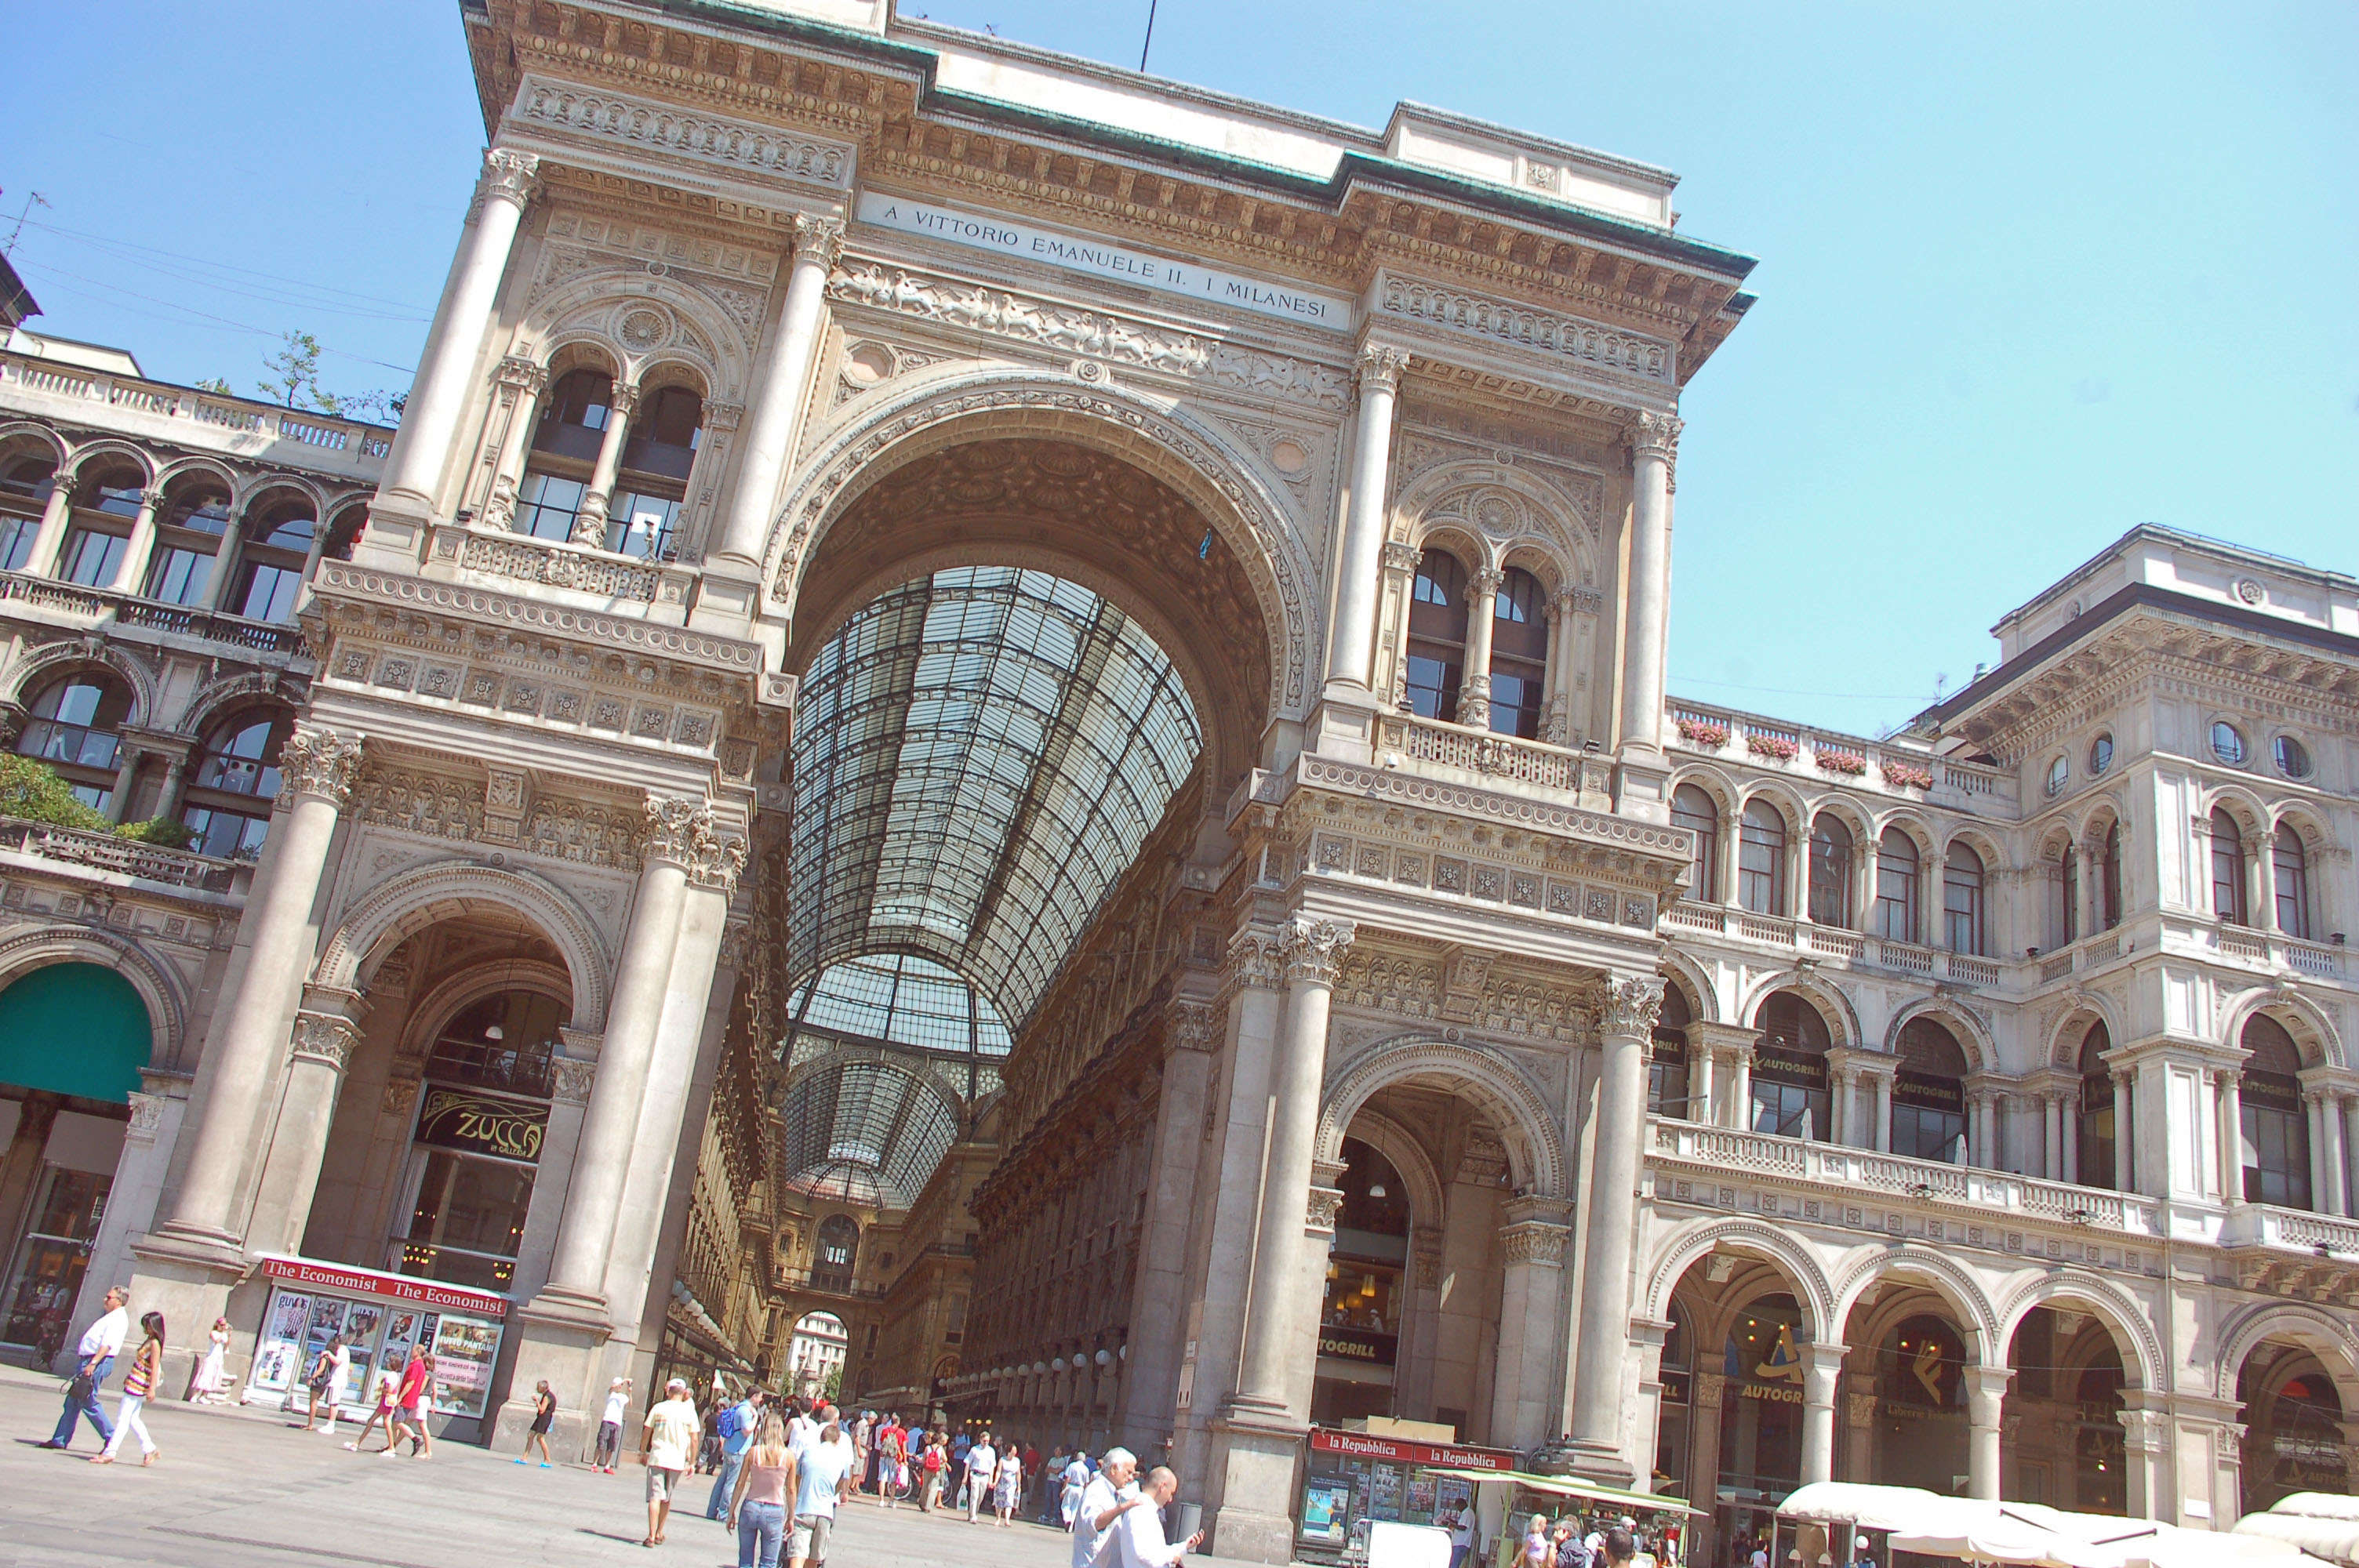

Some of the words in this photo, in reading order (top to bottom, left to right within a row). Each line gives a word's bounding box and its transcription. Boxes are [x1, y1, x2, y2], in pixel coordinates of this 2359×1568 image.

[885, 206, 897, 220] A
[916, 211, 1018, 245] VITTORIO
[1032, 238, 1154, 278] EMANUELE
[1168, 268, 1187, 285] II.
[1206, 278, 1212, 291] I
[1226, 282, 1325, 317] MILANESI
[1764, 1058, 1821, 1076] AUTOGRILL
[456, 1112, 541, 1158] ZUCCA
[267, 1260, 296, 1278] The
[300, 1263, 378, 1292] Economist
[394, 1282, 422, 1300] The
[426, 1286, 503, 1313] Economist
[1329, 1436, 1339, 1449] la
[1341, 1436, 1397, 1456] Repubblica
[1430, 1448, 1441, 1463] la
[1442, 1450, 1496, 1468] Repubblica
